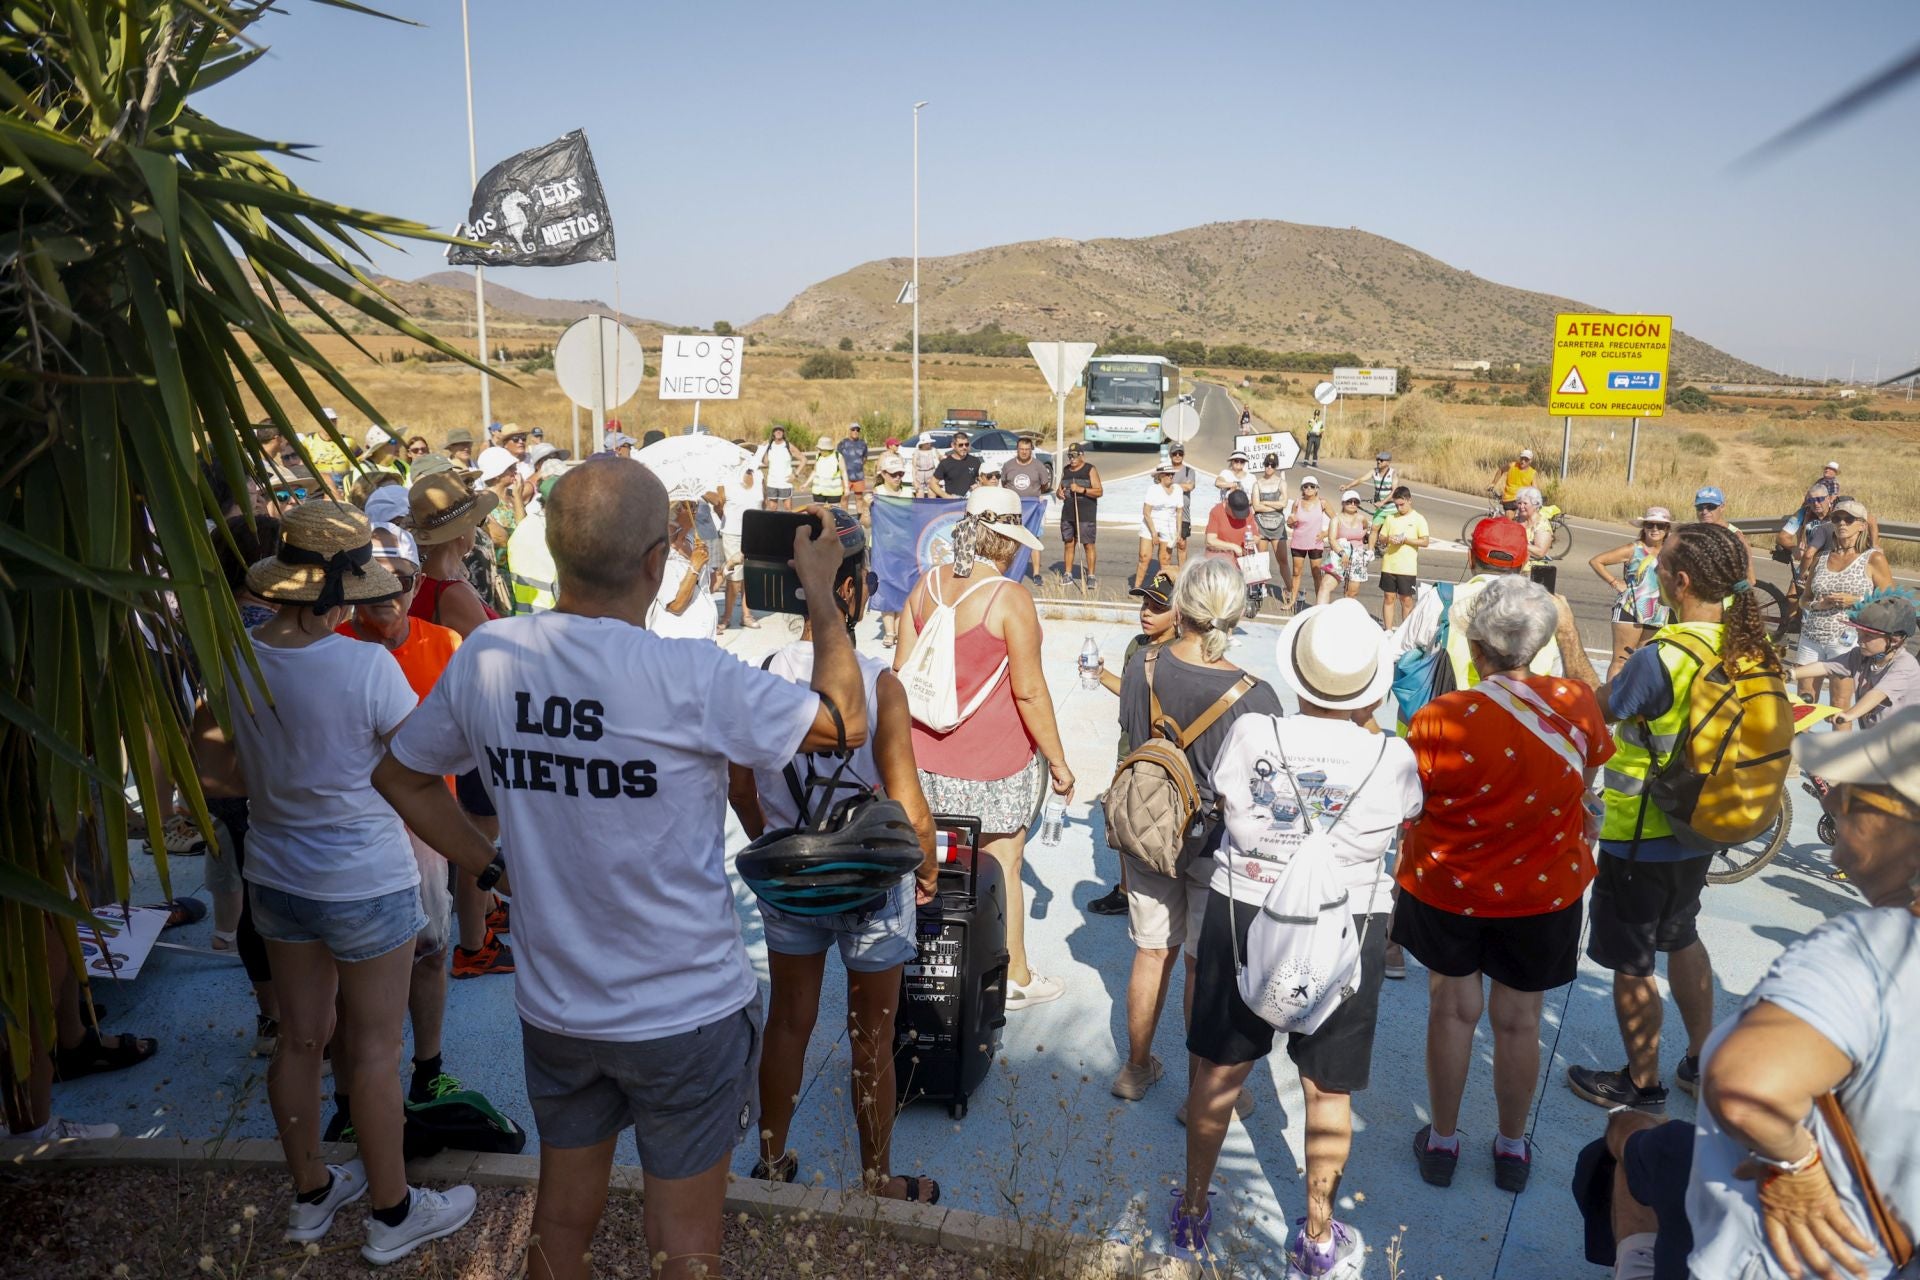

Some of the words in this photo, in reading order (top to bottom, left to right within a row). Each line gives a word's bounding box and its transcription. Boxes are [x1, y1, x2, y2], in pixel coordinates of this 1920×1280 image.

[466, 212, 497, 242] SOS
[541, 213, 599, 246] NIETOS
[1567, 320, 1660, 337] ATENCIÓN
[1557, 340, 1604, 348] CARRETERA
[1609, 341, 1667, 350] FRECUENTADA
[1601, 351, 1642, 359] CICLISTAS
[664, 376, 733, 395] NIETOS
[1551, 401, 1585, 410] CIRCULE
[1590, 402, 1607, 410] CON
[1253, 443, 1282, 452] ESTRECHO
[1247, 462, 1258, 470] LA
[515, 691, 604, 742] LOS
[484, 745, 658, 798] NIETOS
[912, 994, 945, 1002] VONYX
